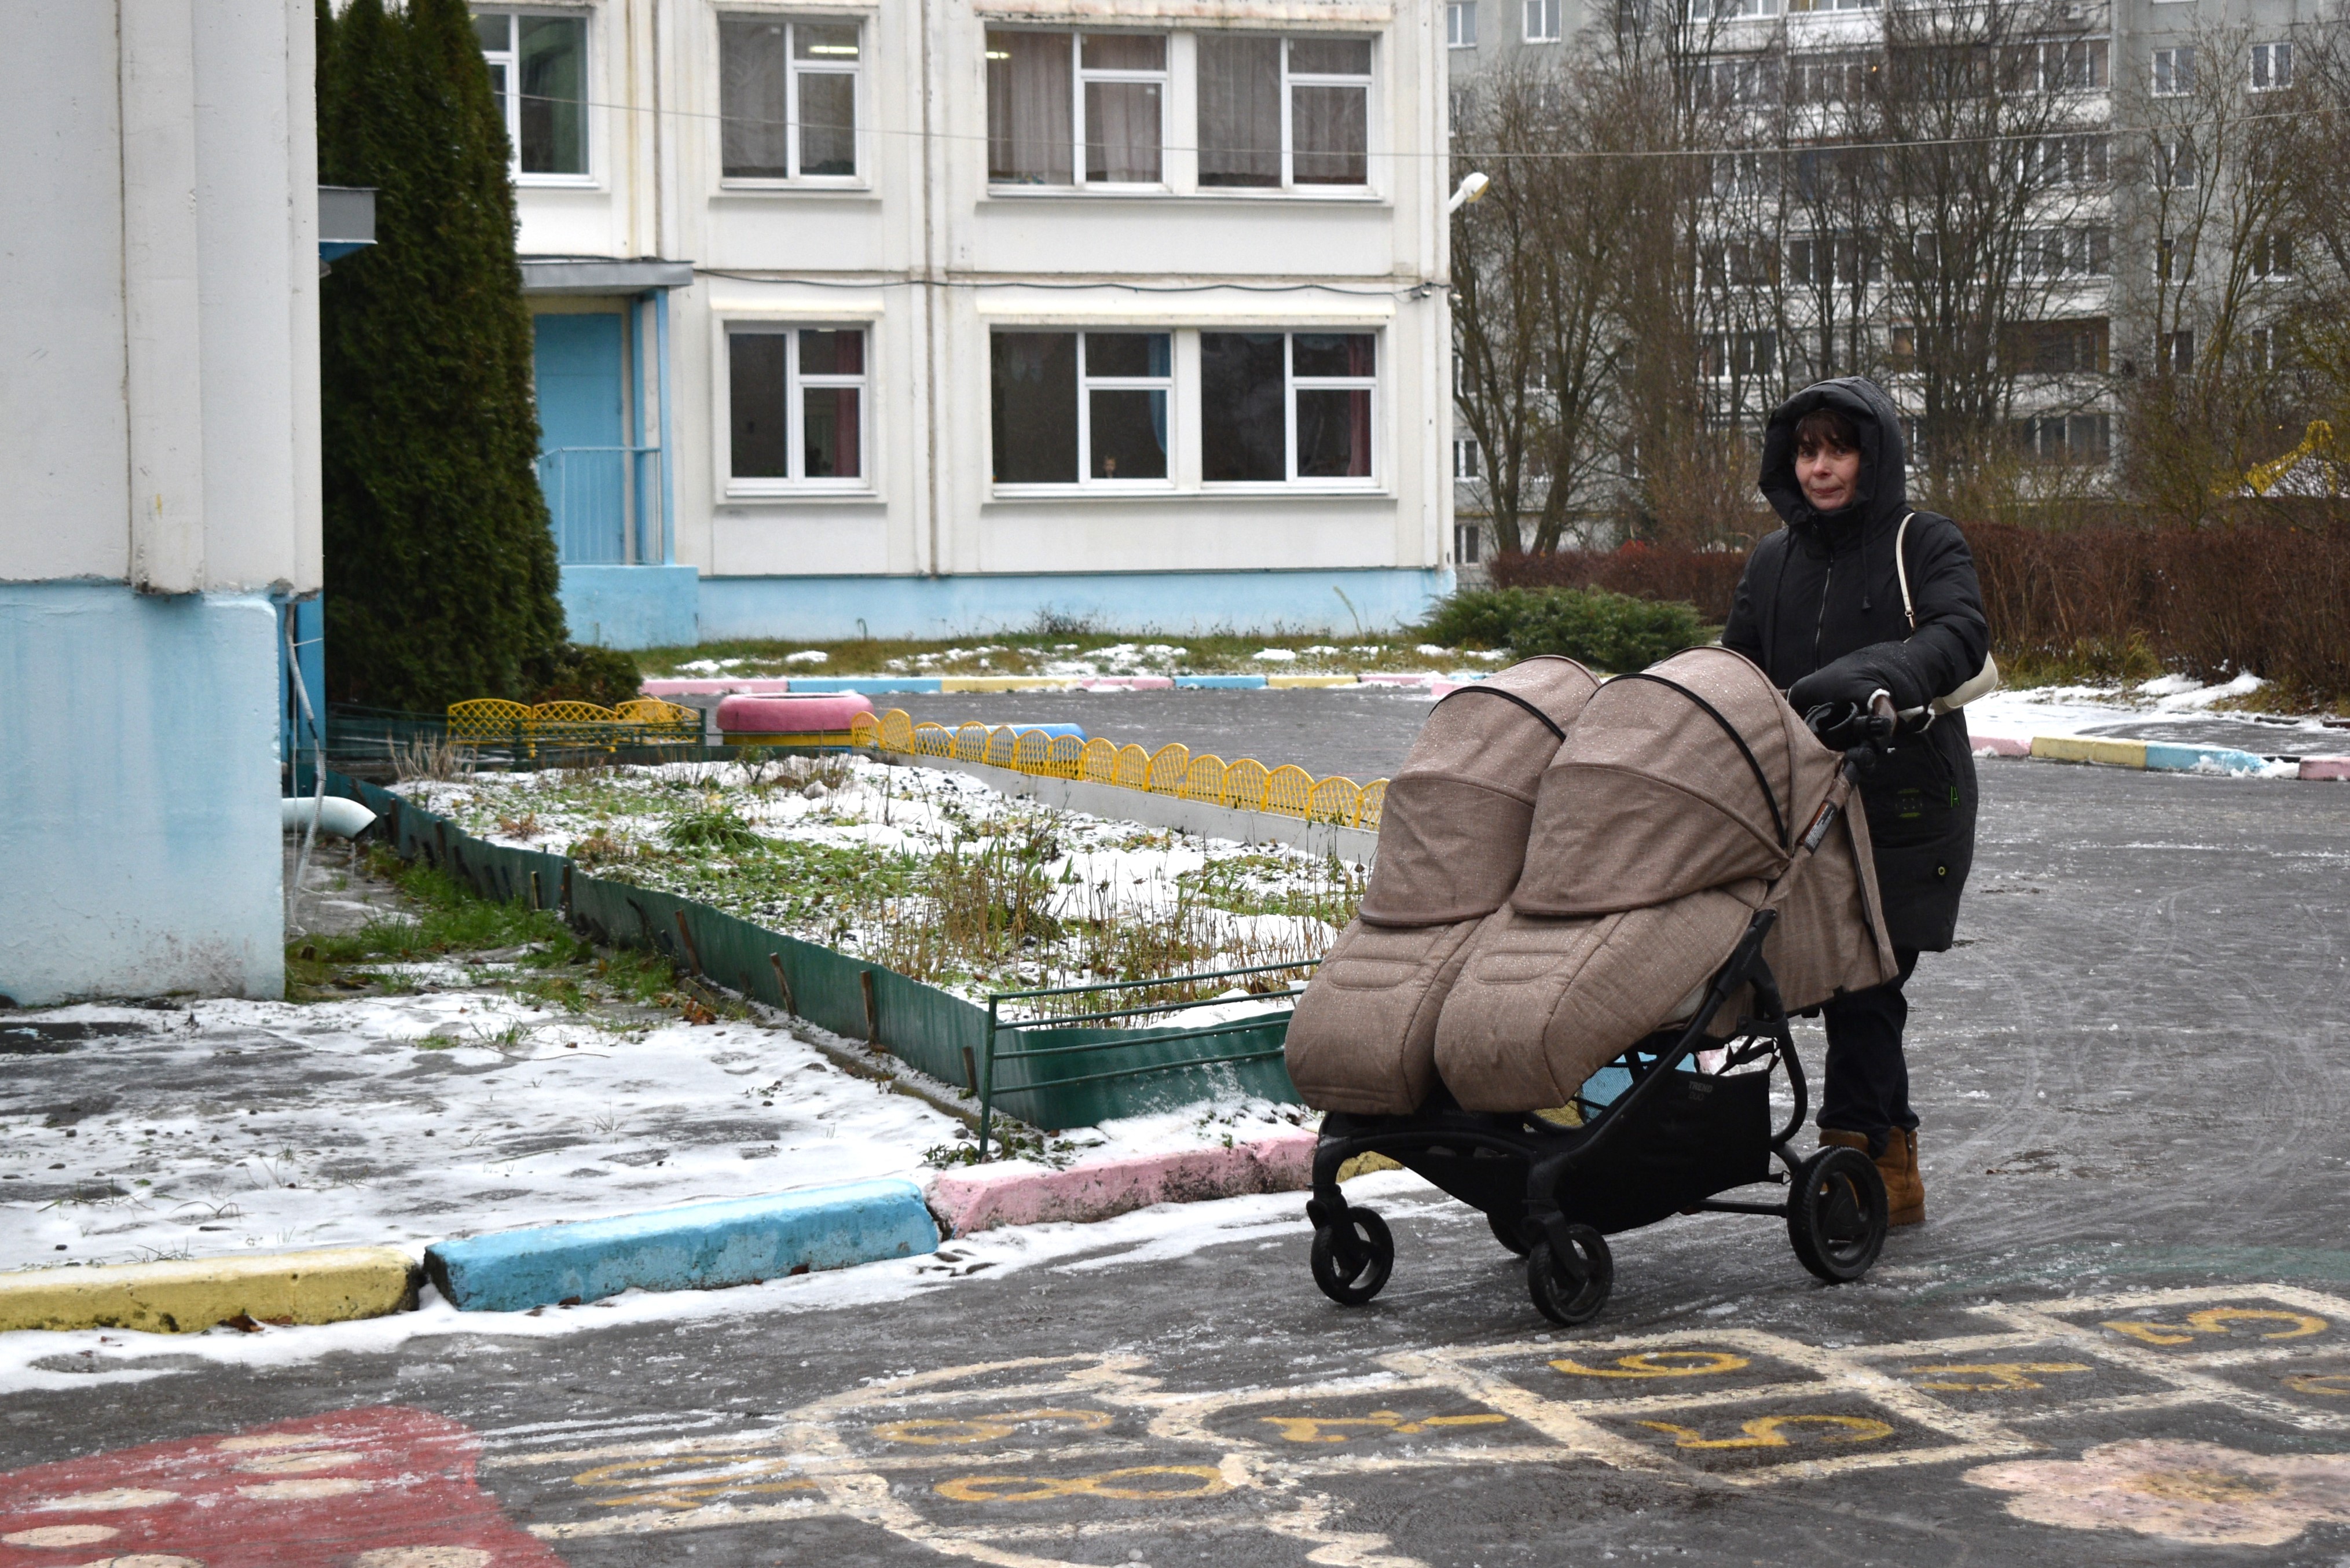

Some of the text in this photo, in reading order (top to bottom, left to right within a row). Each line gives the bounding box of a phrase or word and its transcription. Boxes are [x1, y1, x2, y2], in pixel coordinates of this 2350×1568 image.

[1688, 1091, 1704, 1101] DUO
[1689, 1081, 1713, 1093] TREND
[2098, 1306, 2328, 1345] 3
[1549, 1352, 1750, 1378] 6
[1906, 1361, 2094, 1390] 4
[871, 1408, 1113, 1444] 9
[1259, 1410, 1508, 1442] 7
[1634, 1414, 1895, 1448] 5
[934, 1464, 1230, 1502] 8
